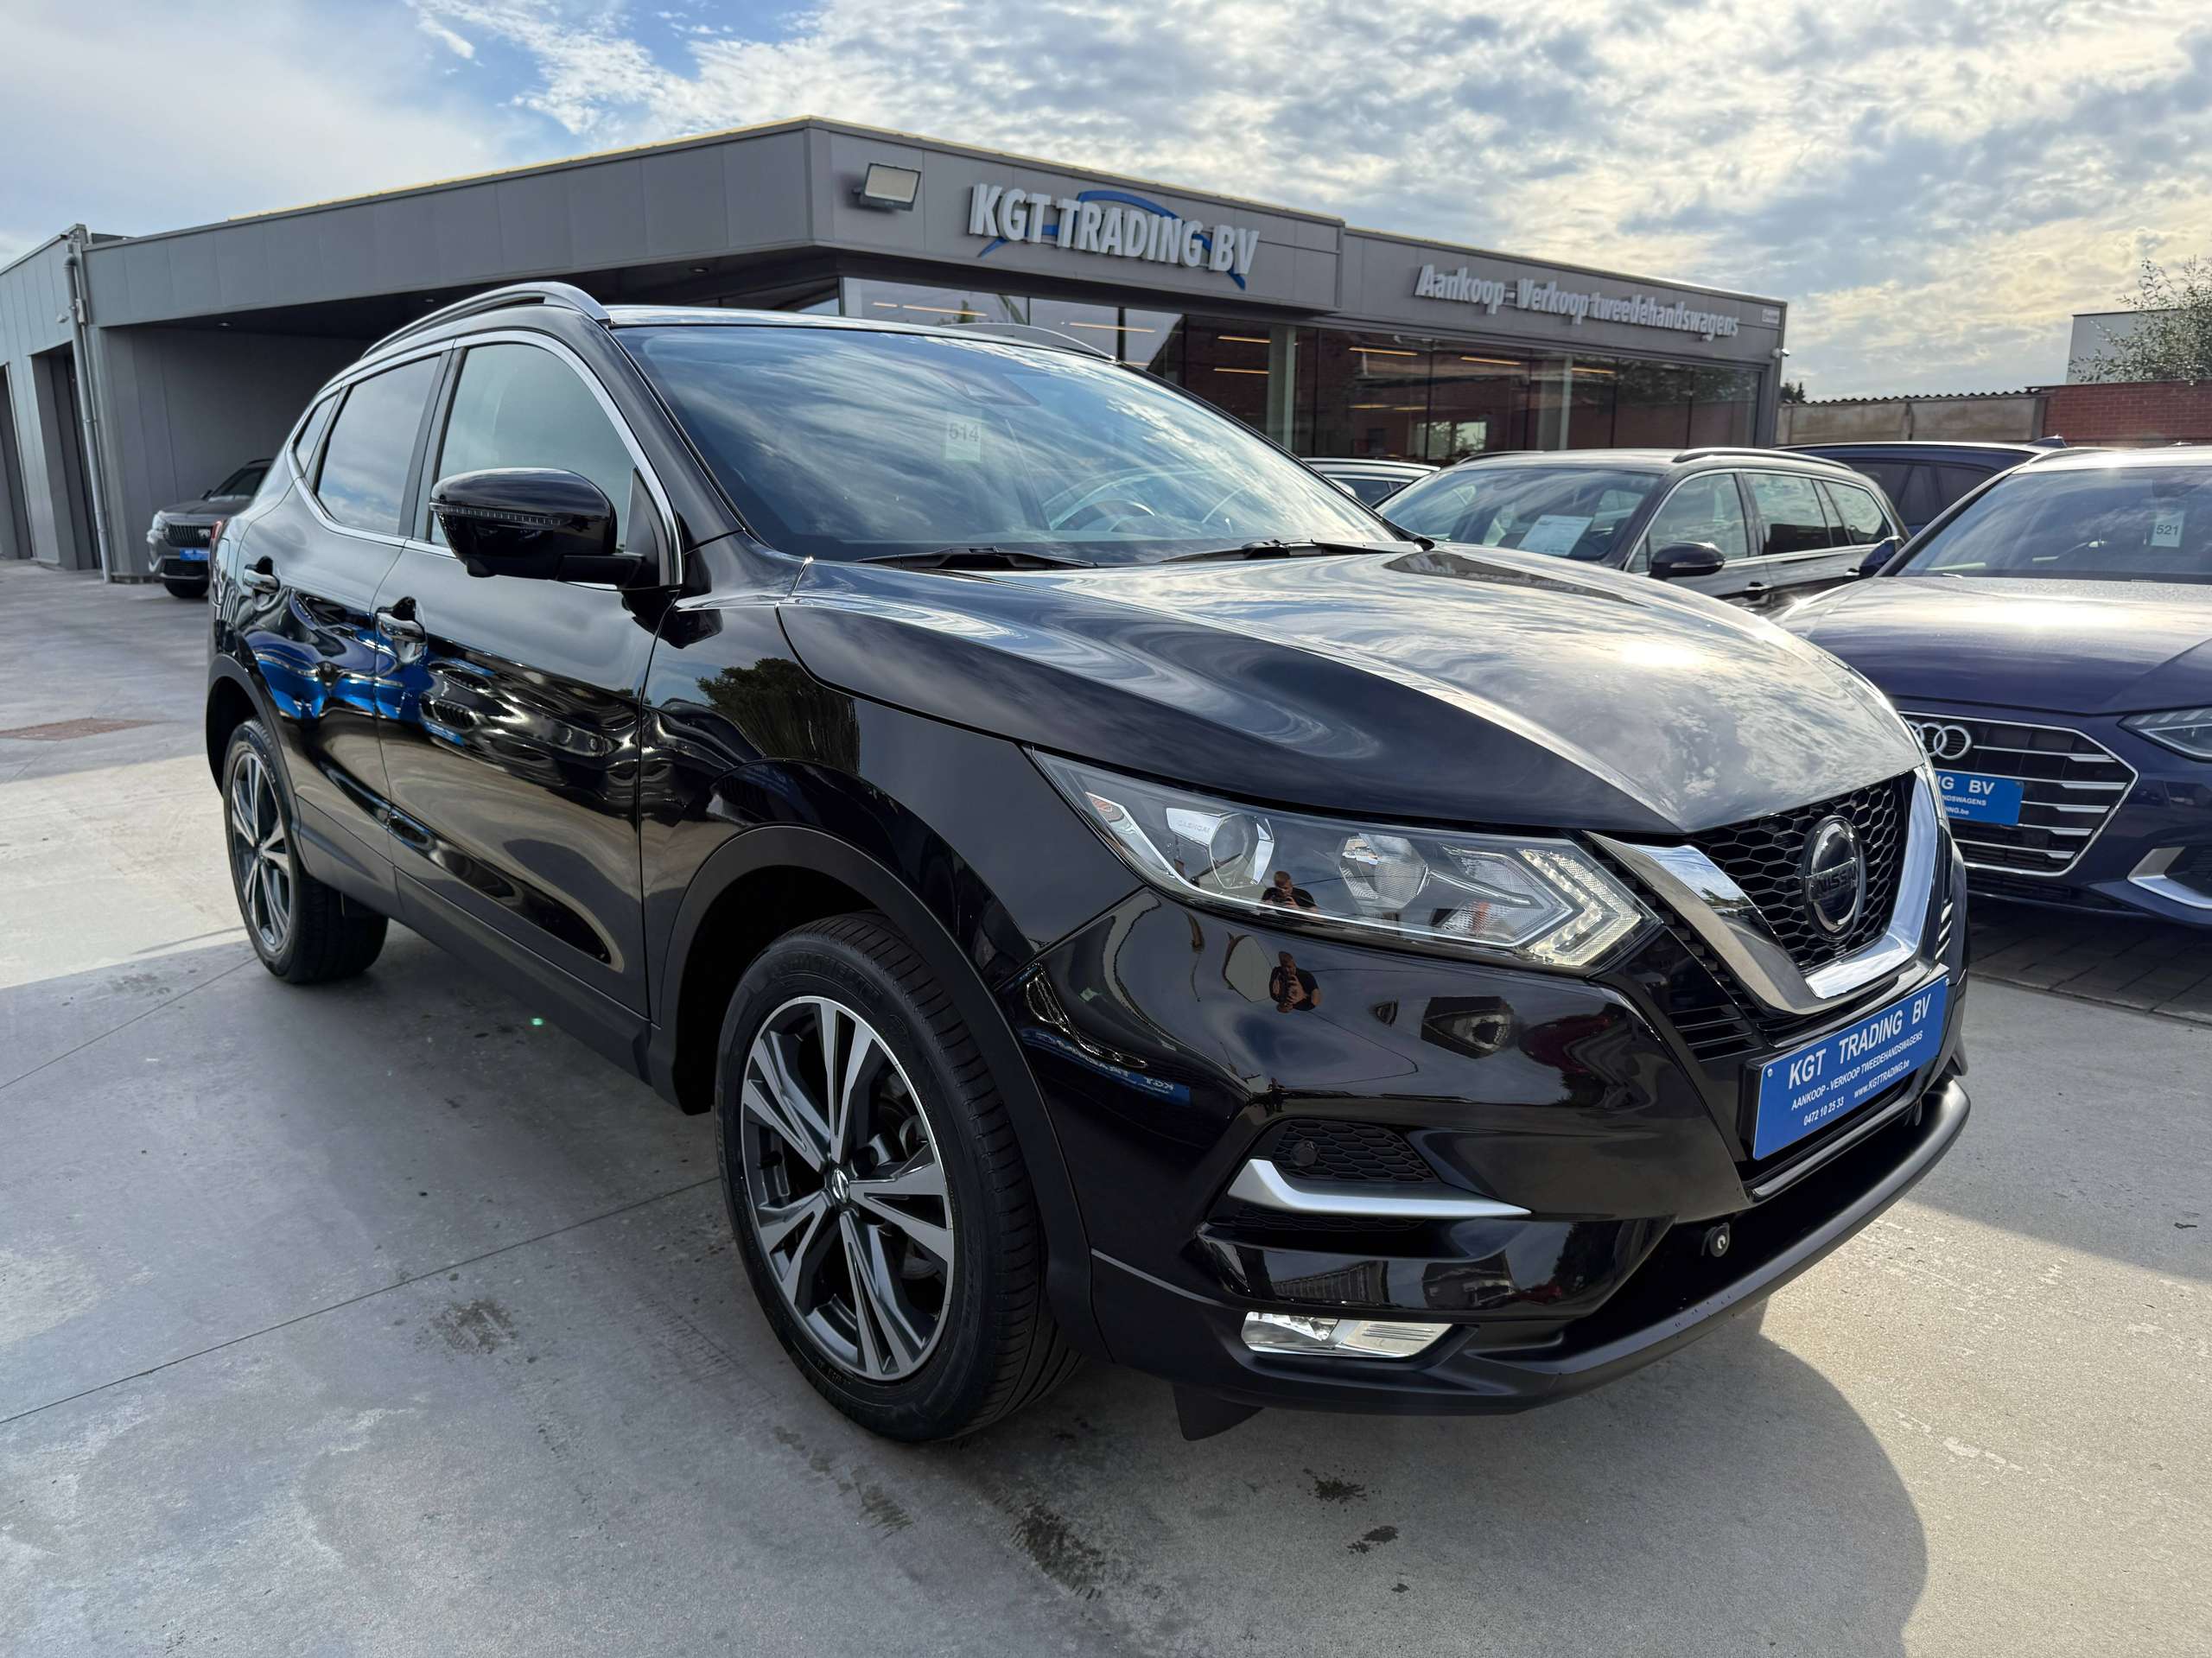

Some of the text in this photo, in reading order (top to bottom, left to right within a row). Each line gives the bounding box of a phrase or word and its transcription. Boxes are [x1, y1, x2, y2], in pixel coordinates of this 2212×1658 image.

[969, 183, 1260, 275] KGT TRADING BV
[1414, 263, 1505, 315] Aankoop
[1516, 277, 1589, 326] Verkoop
[1590, 292, 1740, 342] tweedehandswagens
[2156, 524, 2180, 536] 521
[1968, 779, 1995, 796] BV
[1789, 993, 1932, 1089] KGT TRADING BV
[1791, 1084, 1826, 1111] AANKOOP
[1830, 1066, 1860, 1091] VERKOOP
[1861, 1029, 1923, 1074] TWEEDEHANDSWAGENS
[1803, 1059, 1910, 1126] 0472 10 25 33 www.KGTTRADING.be
